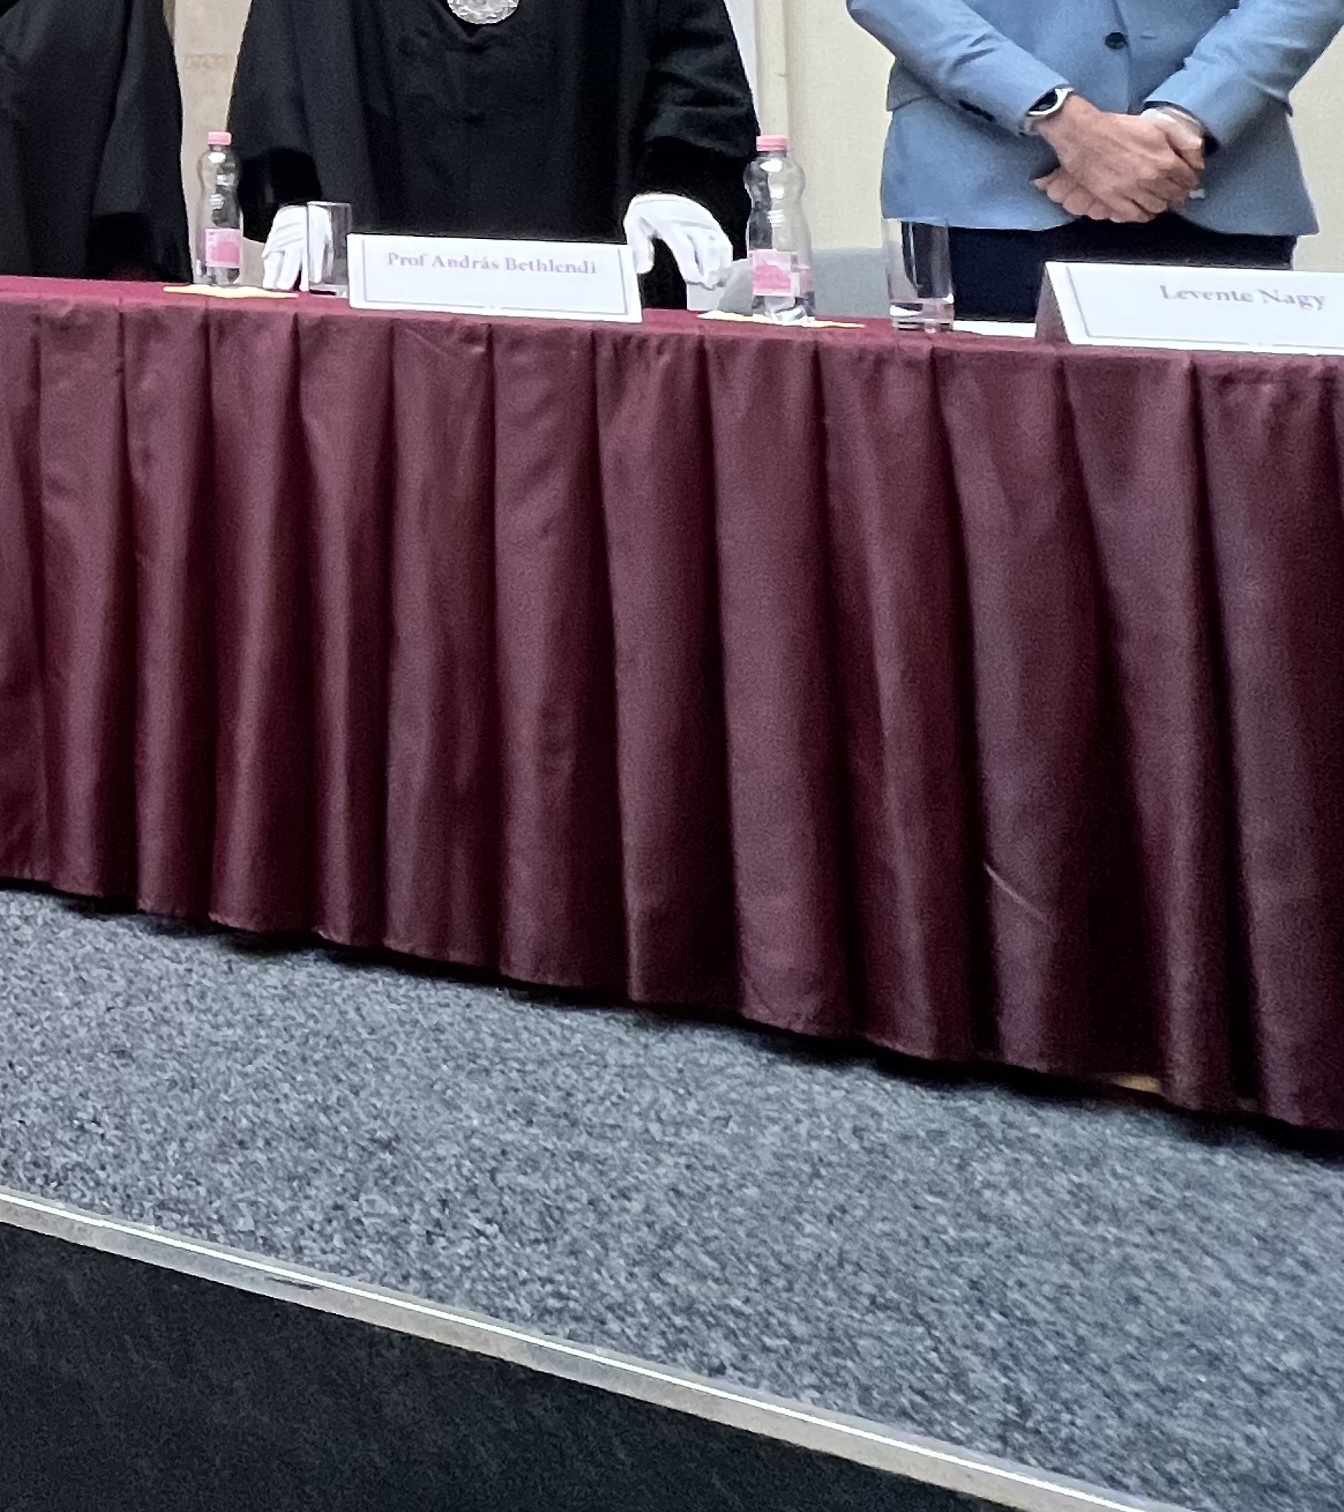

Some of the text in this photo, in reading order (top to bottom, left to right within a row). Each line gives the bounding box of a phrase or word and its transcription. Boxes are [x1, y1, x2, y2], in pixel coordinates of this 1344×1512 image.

[388, 252, 597, 274] Prof András Bethlendi
[1160, 285, 1326, 311] Levente Nagy
